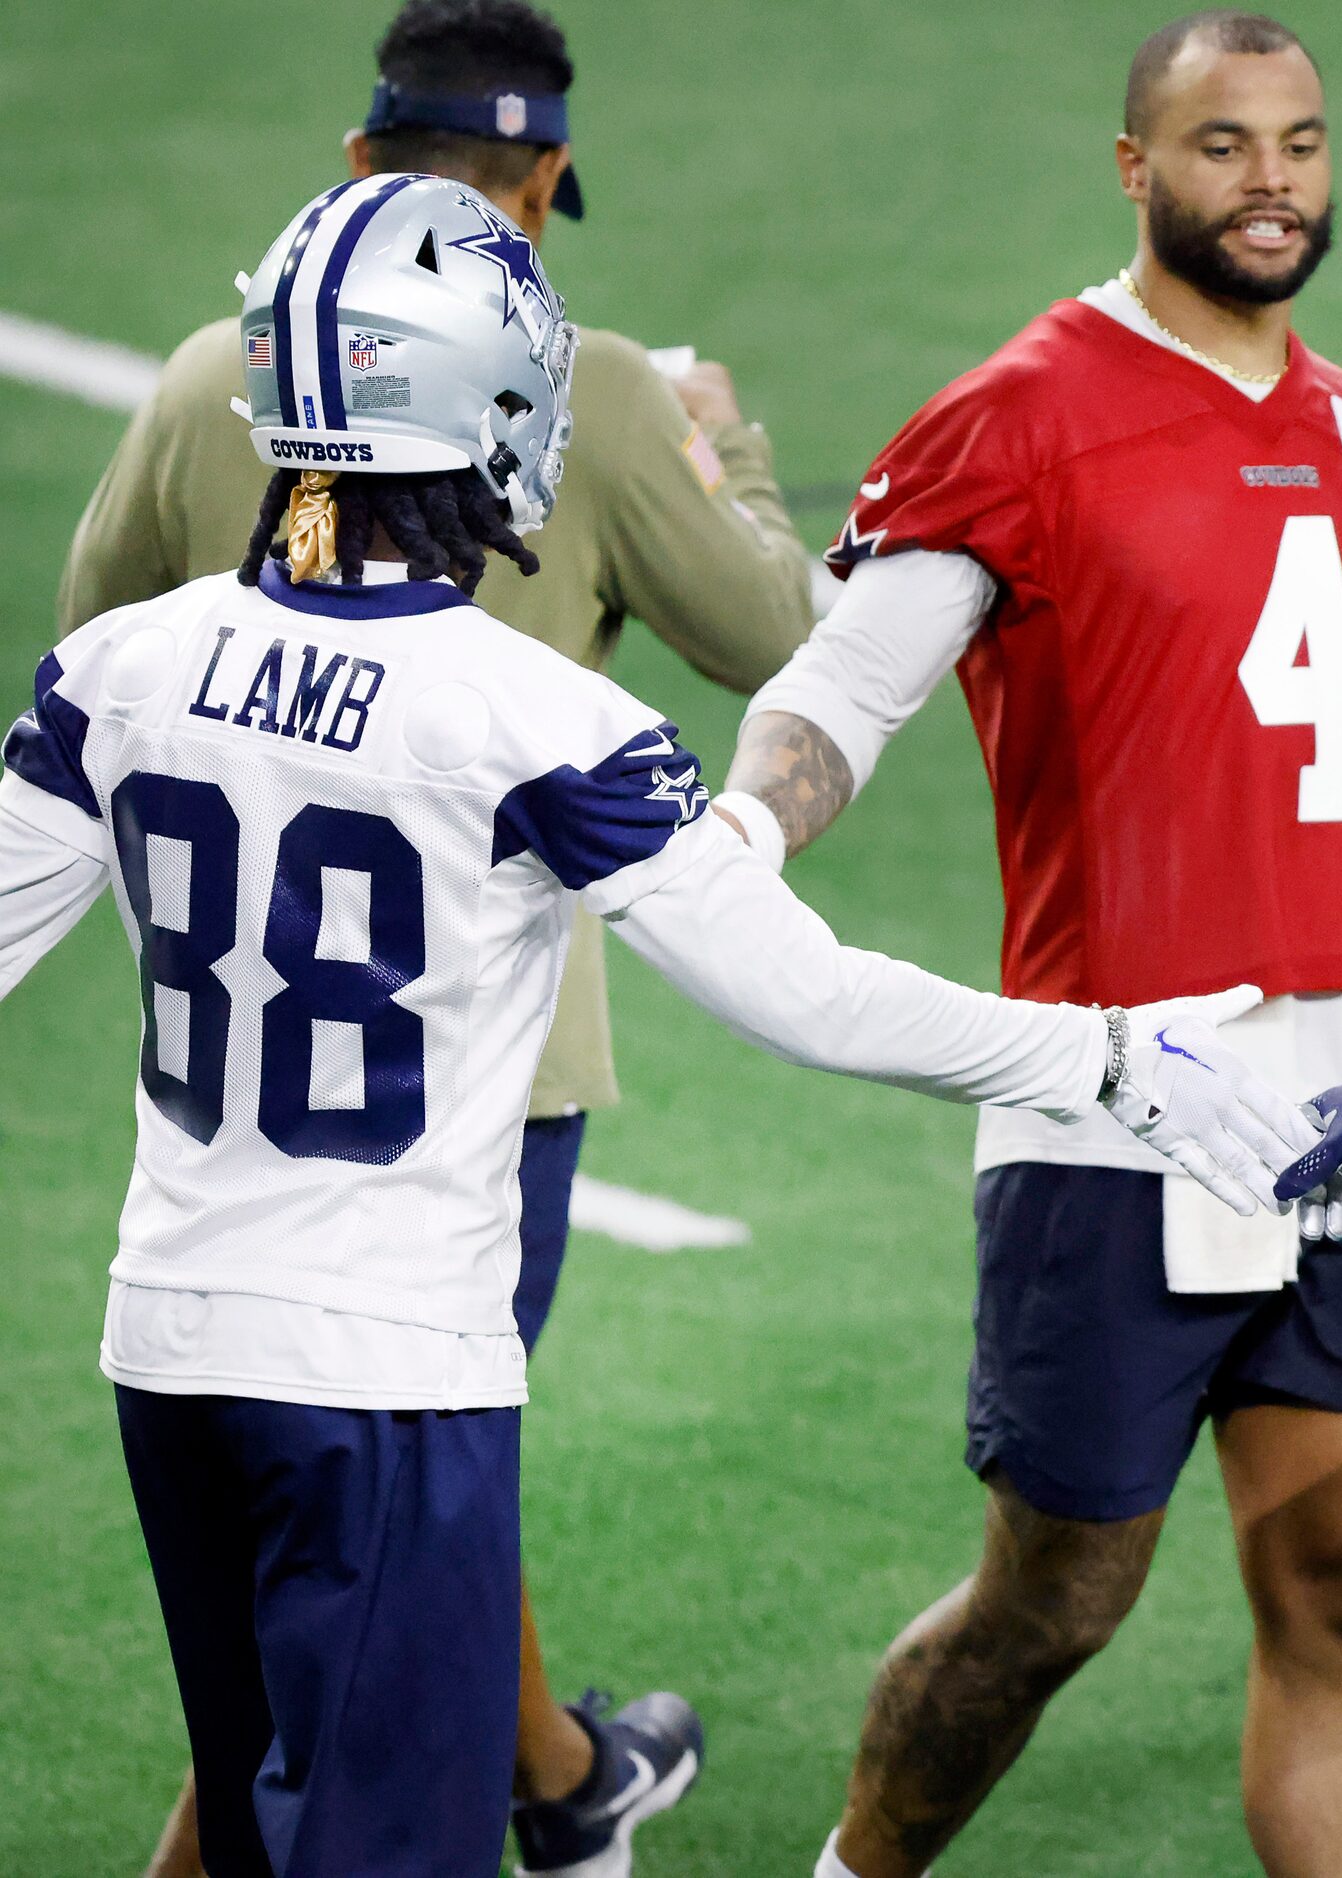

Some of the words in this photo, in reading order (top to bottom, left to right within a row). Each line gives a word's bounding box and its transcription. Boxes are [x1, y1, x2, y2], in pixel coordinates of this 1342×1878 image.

[351, 351, 374, 367] NFL
[270, 439, 374, 462] COWBOYS
[189, 626, 386, 753] LAMB
[111, 769, 426, 1167] 88
